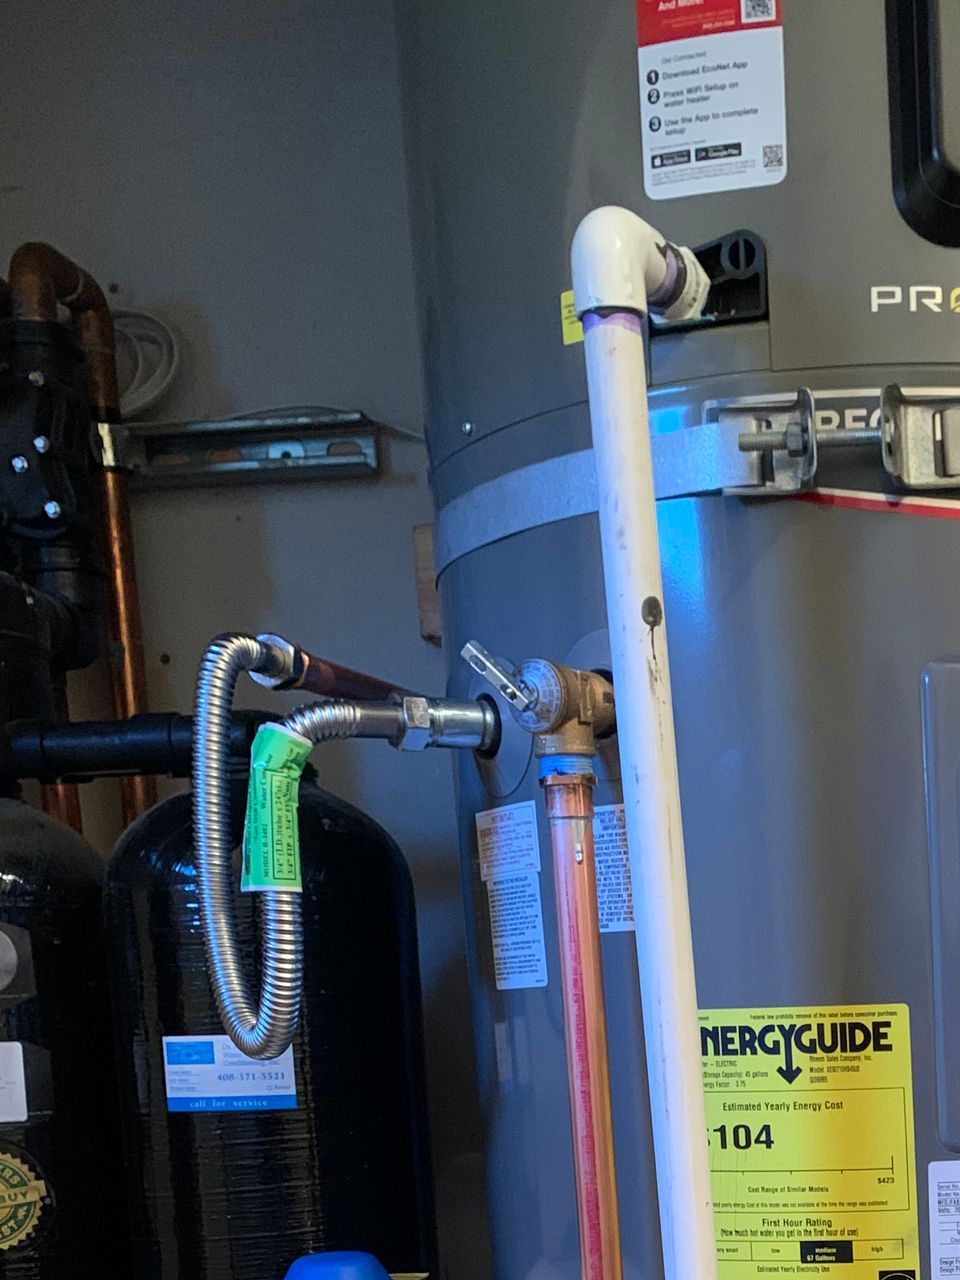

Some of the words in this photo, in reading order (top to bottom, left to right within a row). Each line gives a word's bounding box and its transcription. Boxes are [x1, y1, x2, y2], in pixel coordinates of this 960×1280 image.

[662, 68, 699, 80] Download
[704, 83, 727, 92] Setup
[722, 108, 758, 118] complete
[700, 1021, 893, 1057] NERGYGUIDE
[722, 1102, 762, 1111] Estimated
[765, 1102, 790, 1112] Yearly
[793, 1102, 822, 1112] Energy
[825, 1101, 843, 1110] Cost
[762, 1219, 780, 1227] First
[783, 1219, 802, 1227] Hour
[806, 1218, 832, 1227] Rating
[775, 1230, 785, 1238] you
[787, 1229, 795, 1238] get
[840, 1228, 845, 1236] of
